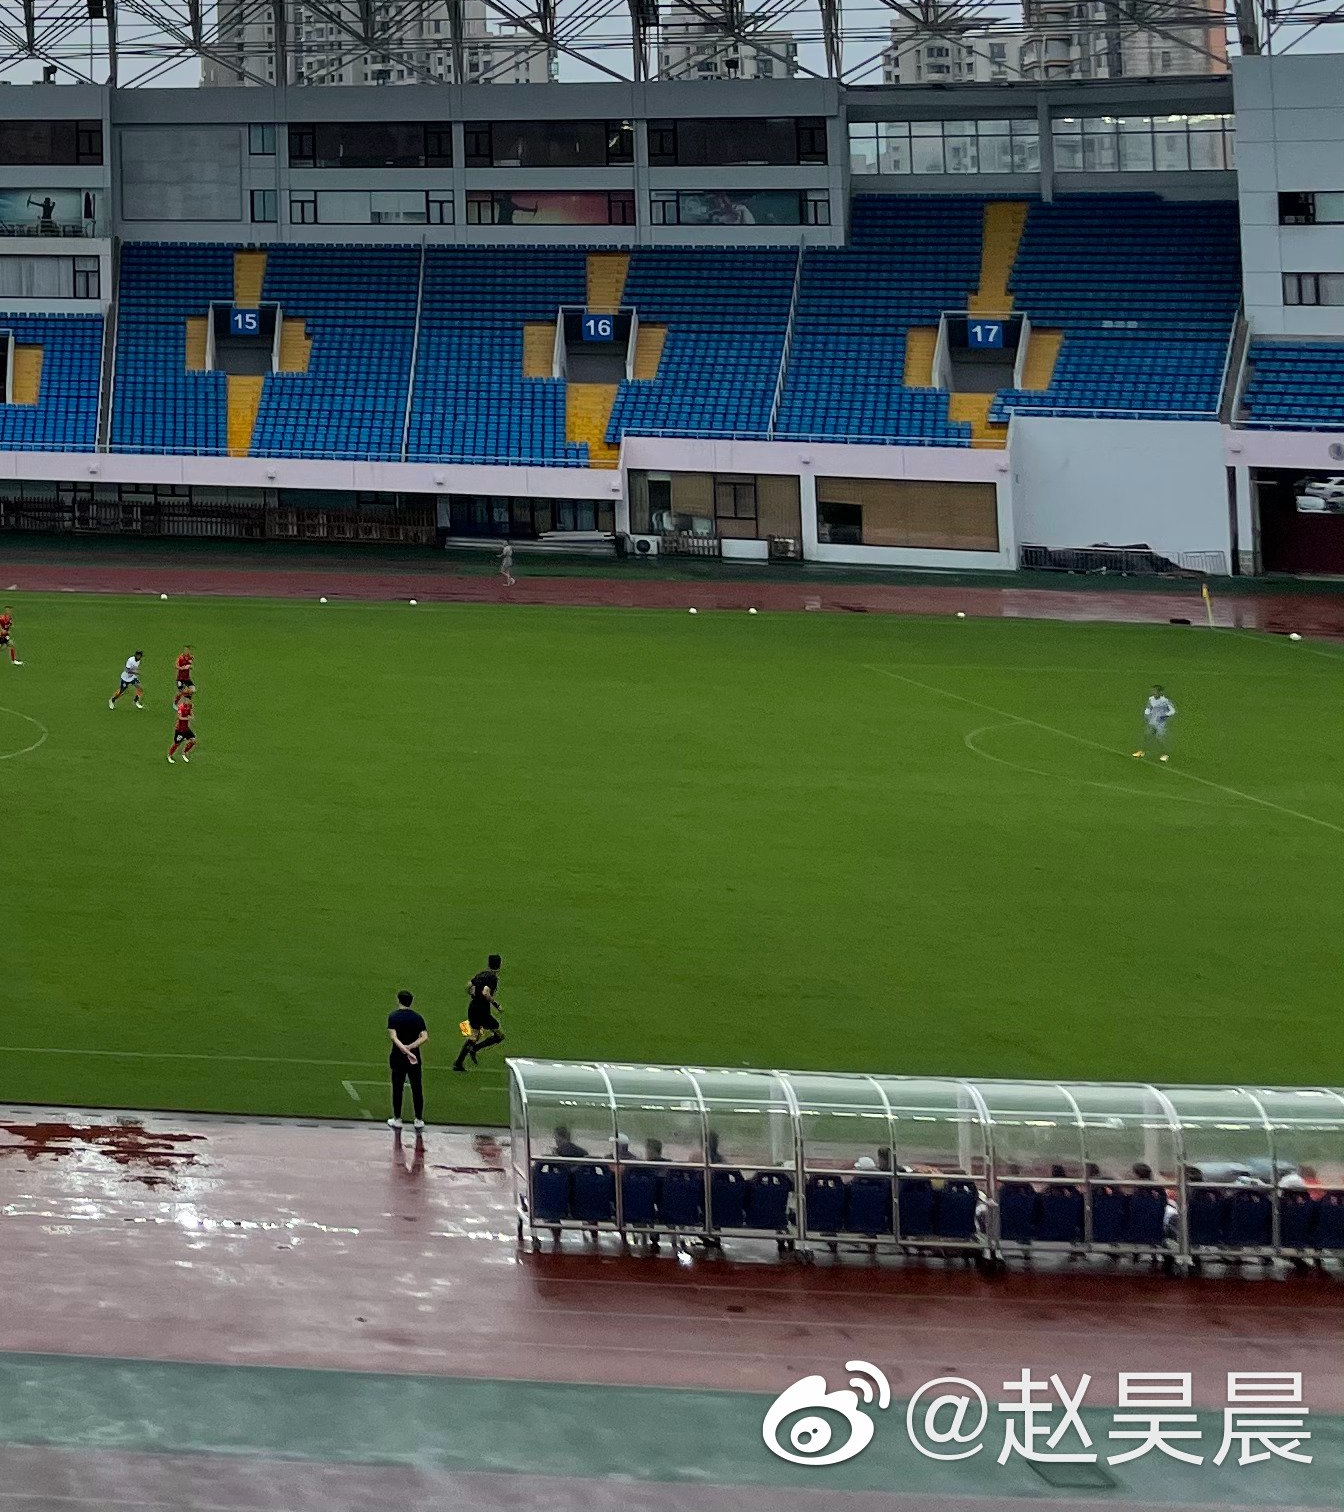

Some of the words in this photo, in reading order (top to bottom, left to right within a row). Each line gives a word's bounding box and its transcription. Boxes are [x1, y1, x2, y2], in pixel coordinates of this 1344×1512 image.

[234, 313, 257, 330] 15
[585, 319, 611, 336] 16
[972, 325, 999, 342] 17
